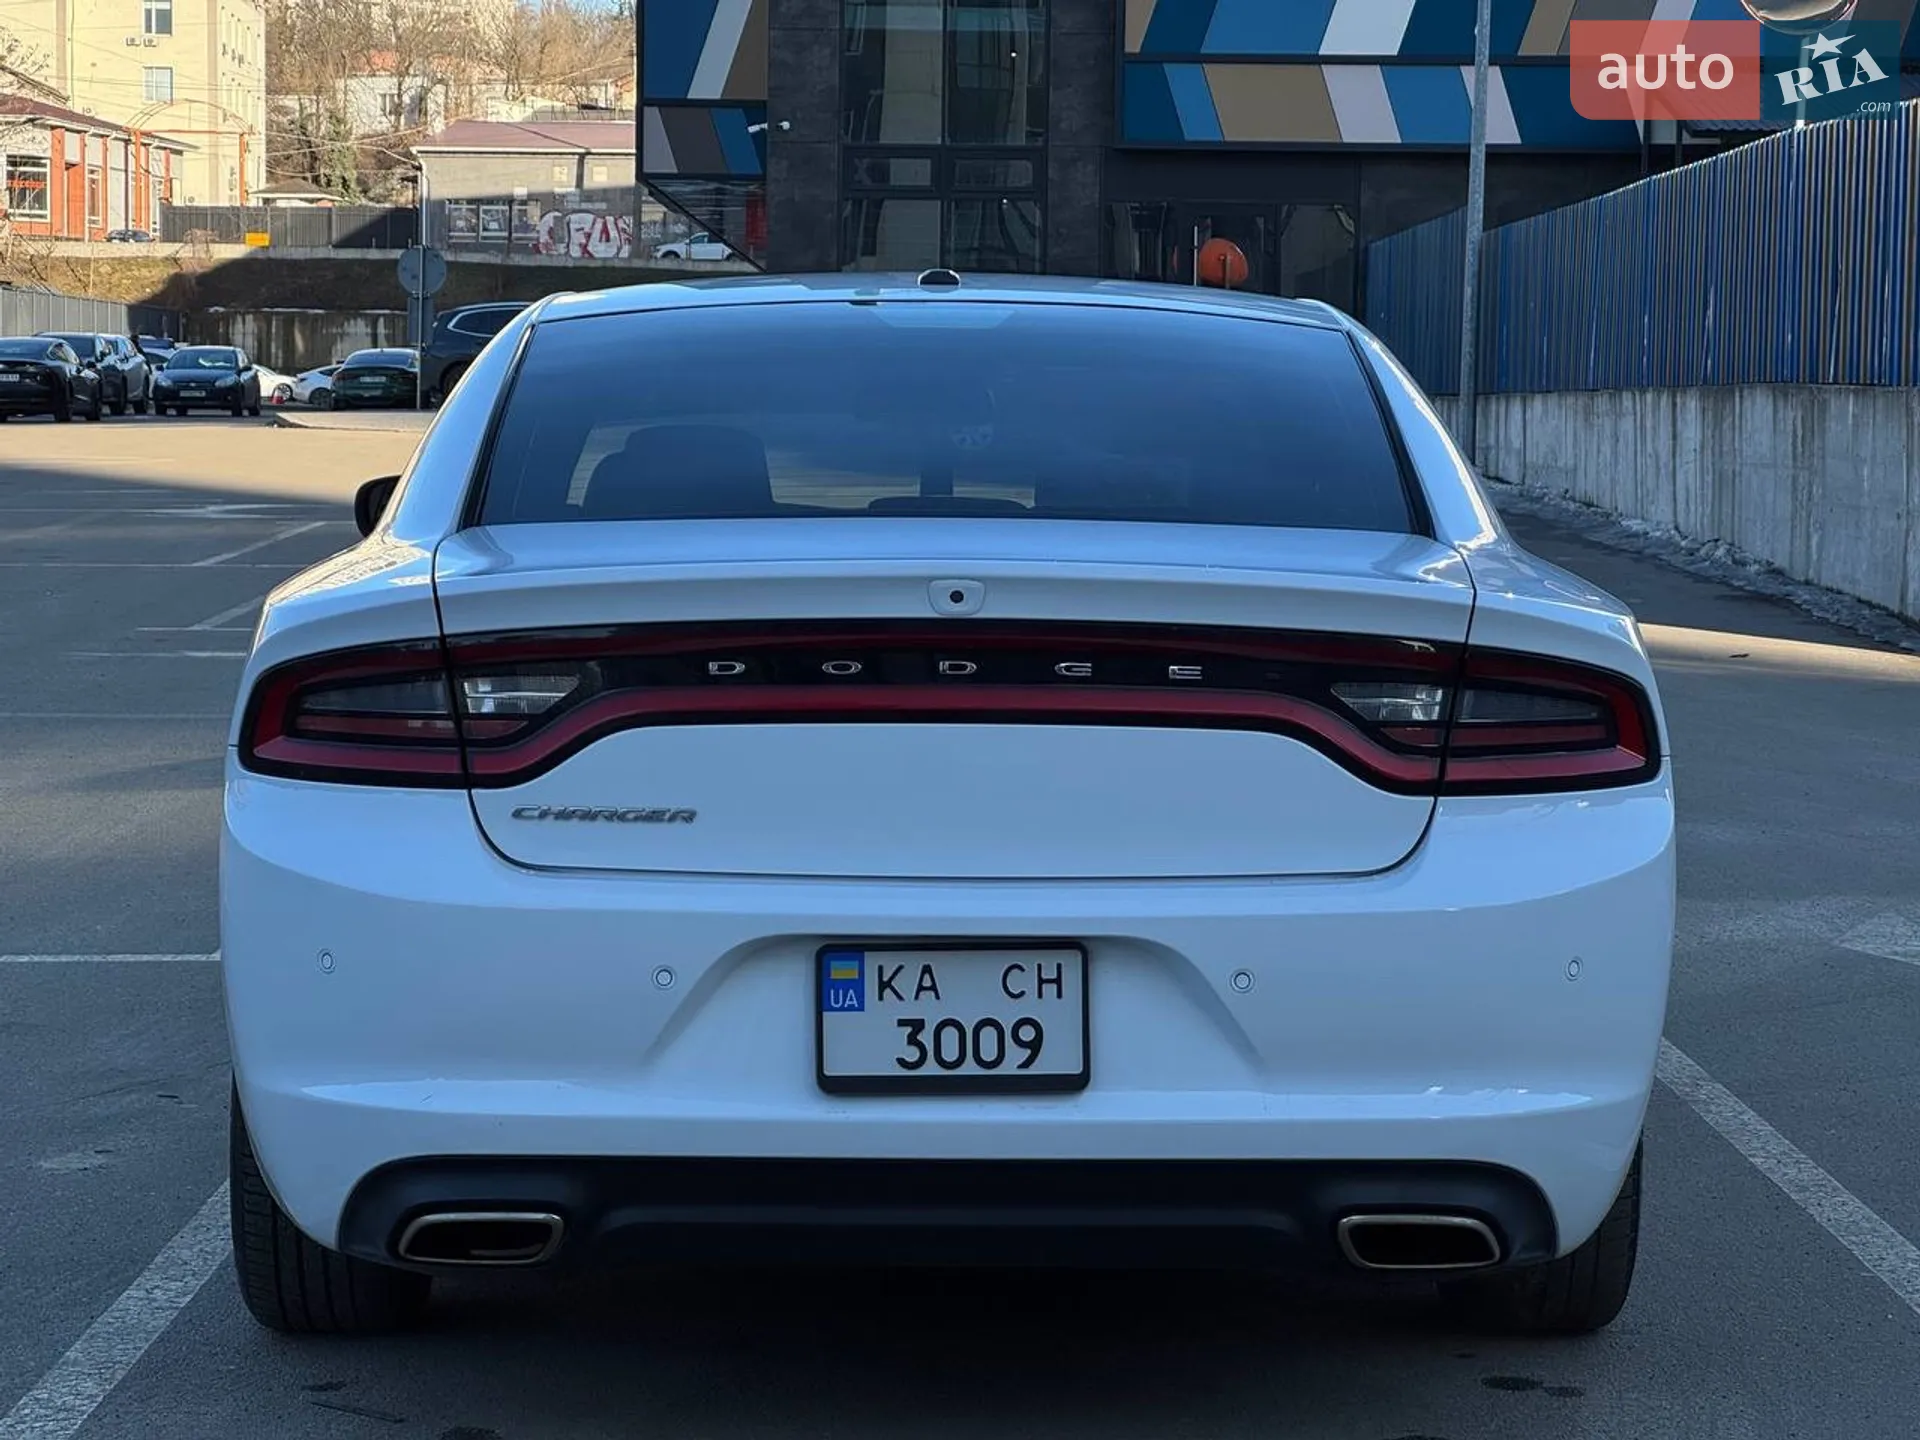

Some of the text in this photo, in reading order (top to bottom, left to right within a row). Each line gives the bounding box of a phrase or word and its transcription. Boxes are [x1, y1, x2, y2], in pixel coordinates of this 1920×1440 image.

[708, 660, 1204, 680] DODGE
[511, 804, 698, 825] CHARGER
[877, 962, 1064, 1002] KA CH
[829, 988, 859, 1009] UA
[895, 1016, 1045, 1071] 3009
